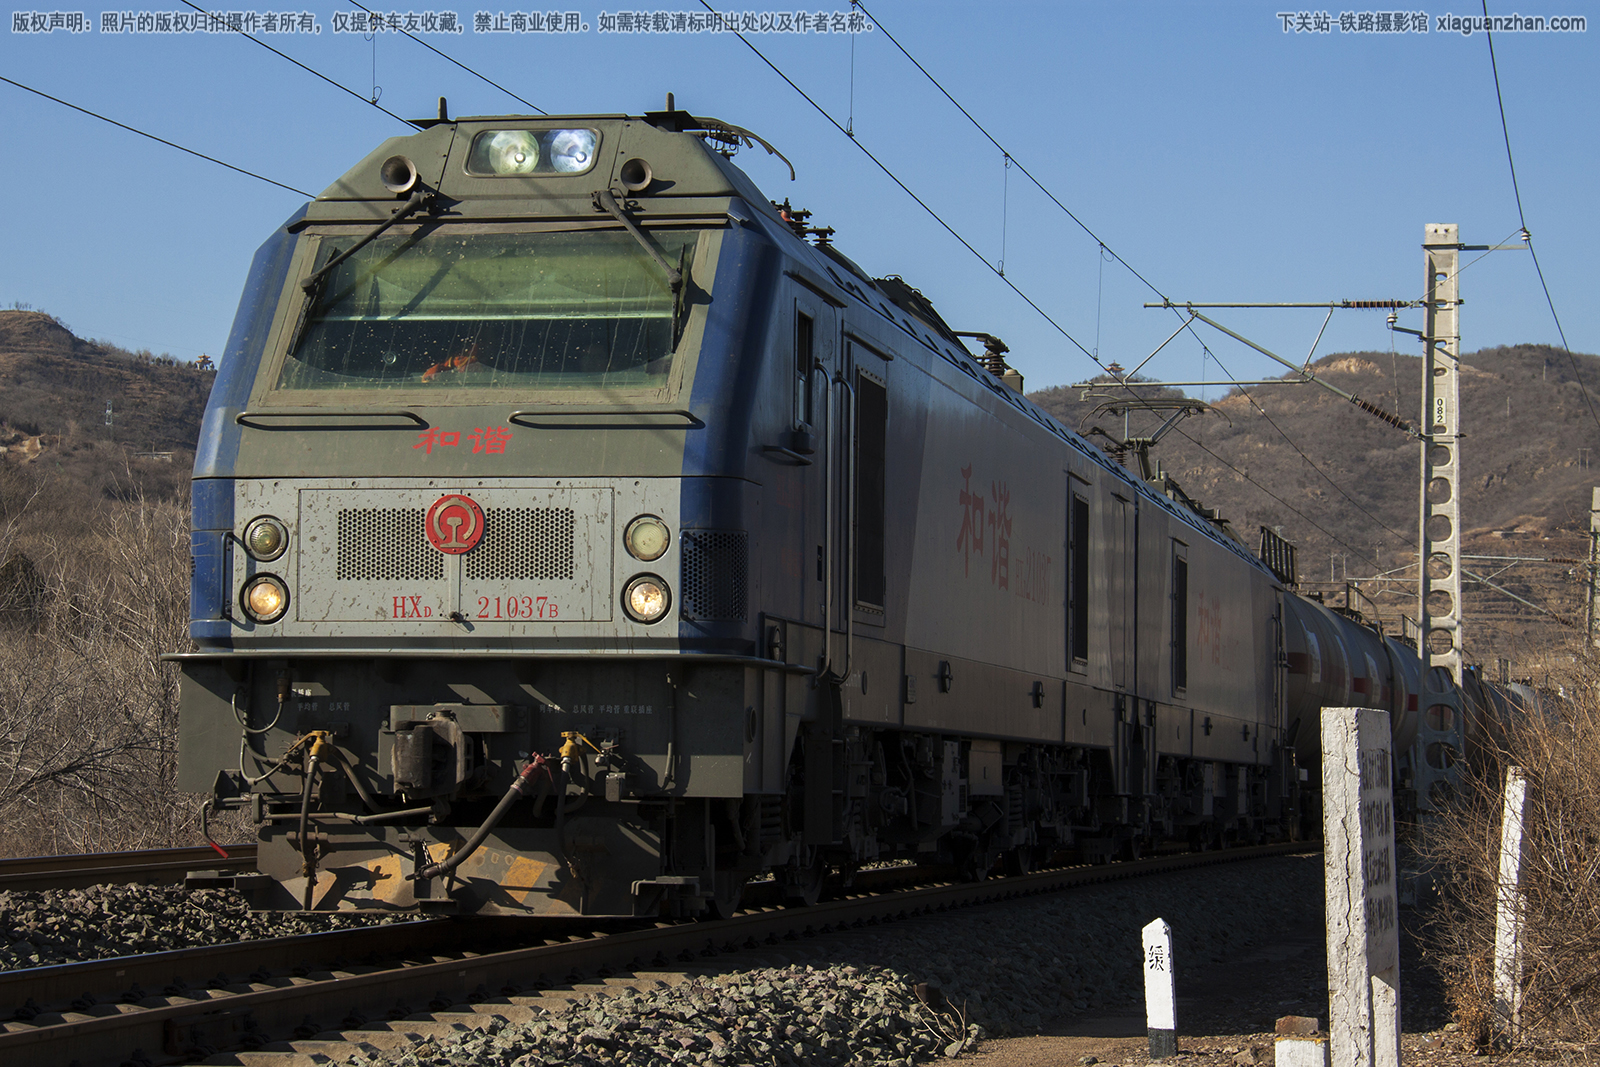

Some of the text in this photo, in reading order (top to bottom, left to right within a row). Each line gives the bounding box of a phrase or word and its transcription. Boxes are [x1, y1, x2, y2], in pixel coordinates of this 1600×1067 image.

[412, 426, 514, 454] 和谐
[956, 463, 1012, 591] 和谐
[392, 596, 559, 618] HXD 21037B
[1197, 588, 1222, 665] 和谐
